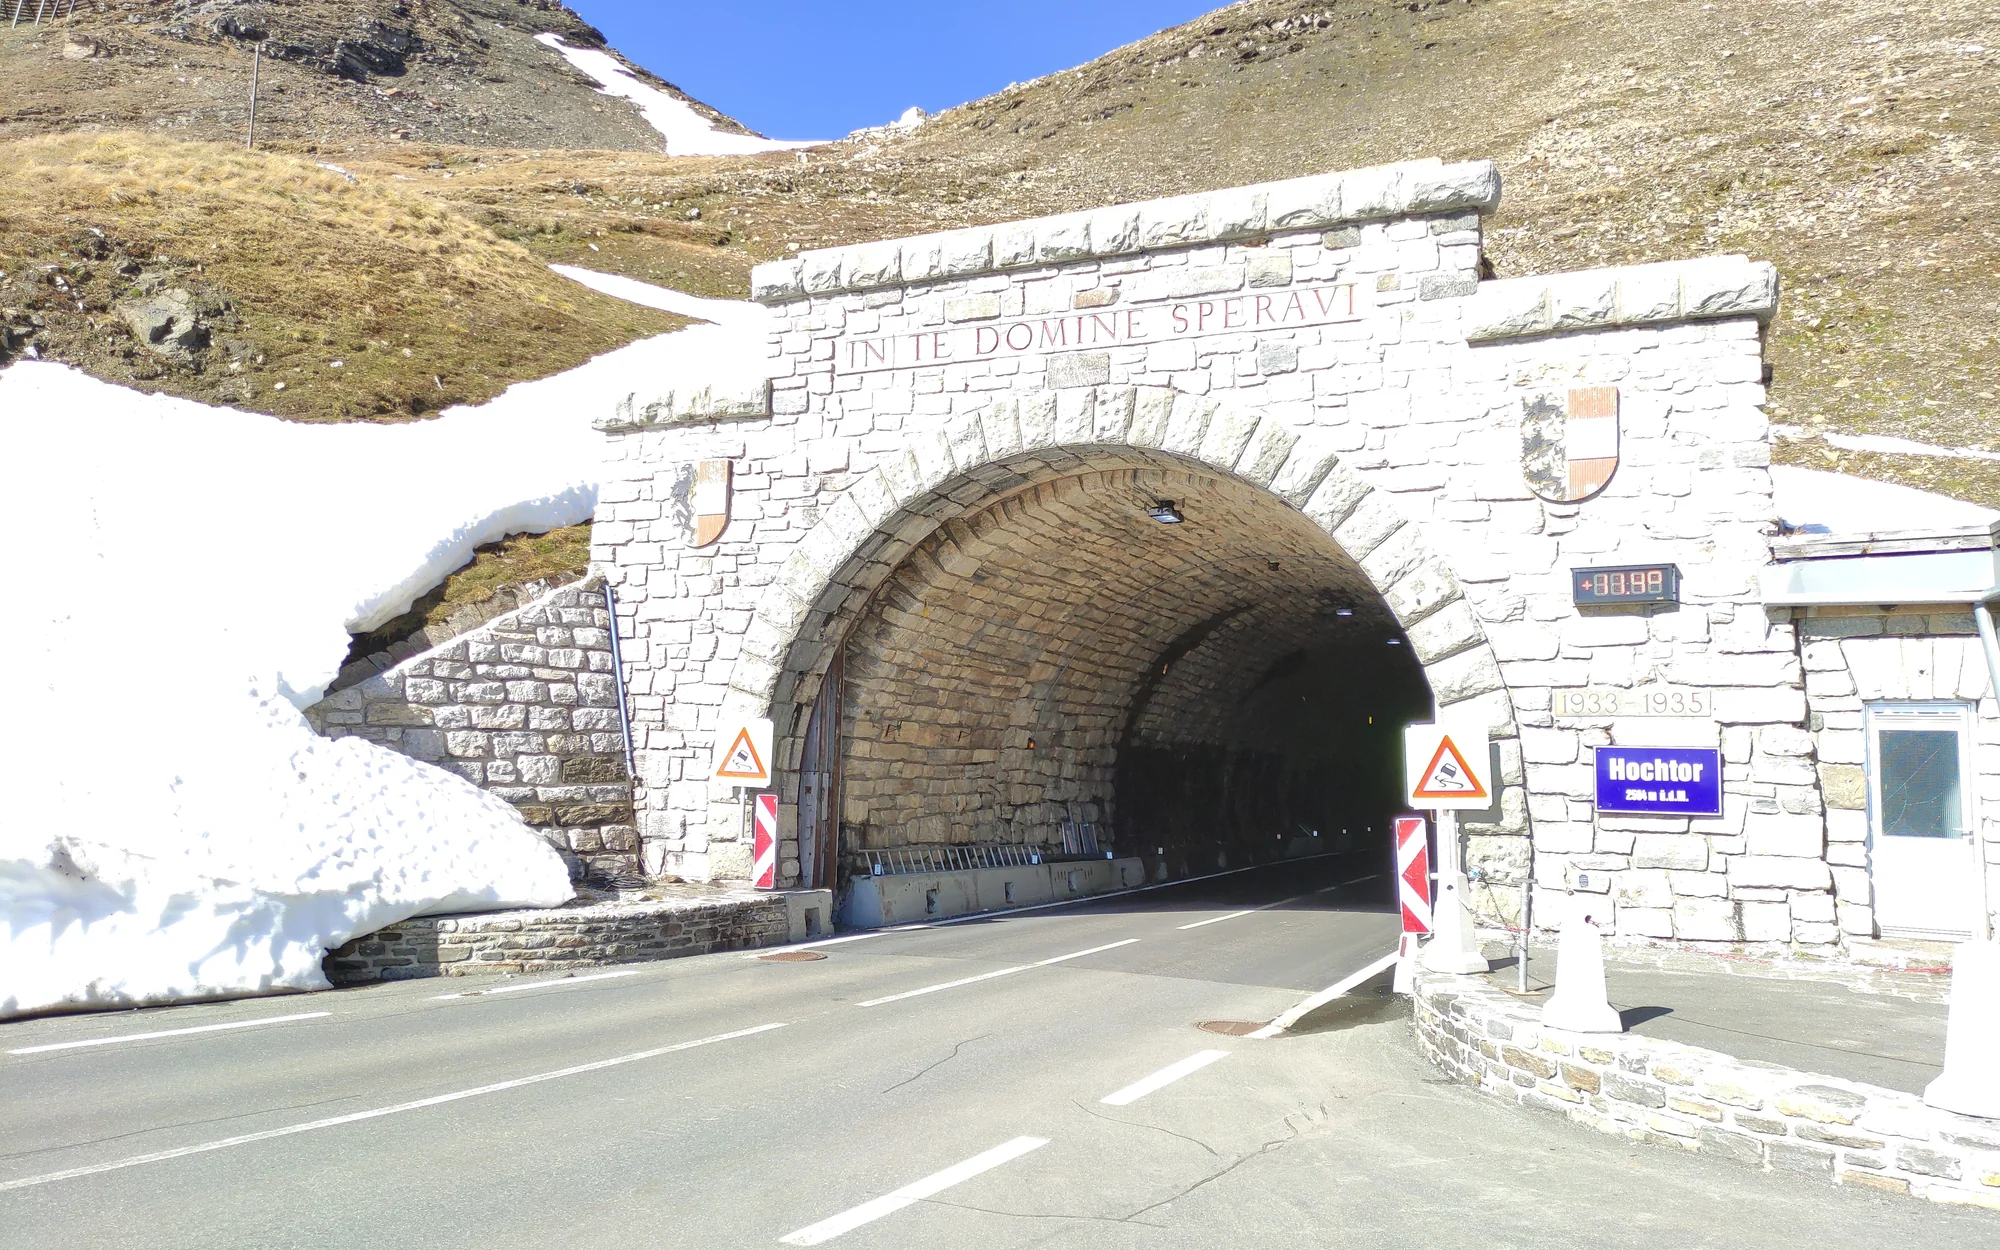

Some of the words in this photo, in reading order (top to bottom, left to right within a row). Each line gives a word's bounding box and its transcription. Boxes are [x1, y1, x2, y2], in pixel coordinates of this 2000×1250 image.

[850, 338, 886, 368] IN
[909, 331, 953, 361] TE
[975, 310, 1148, 355] DOMINE
[1171, 283, 1357, 334] SPERAVI
[1562, 692, 1618, 714] 1933
[1643, 692, 1703, 714] 1935
[1609, 757, 1704, 782] Hochtor
